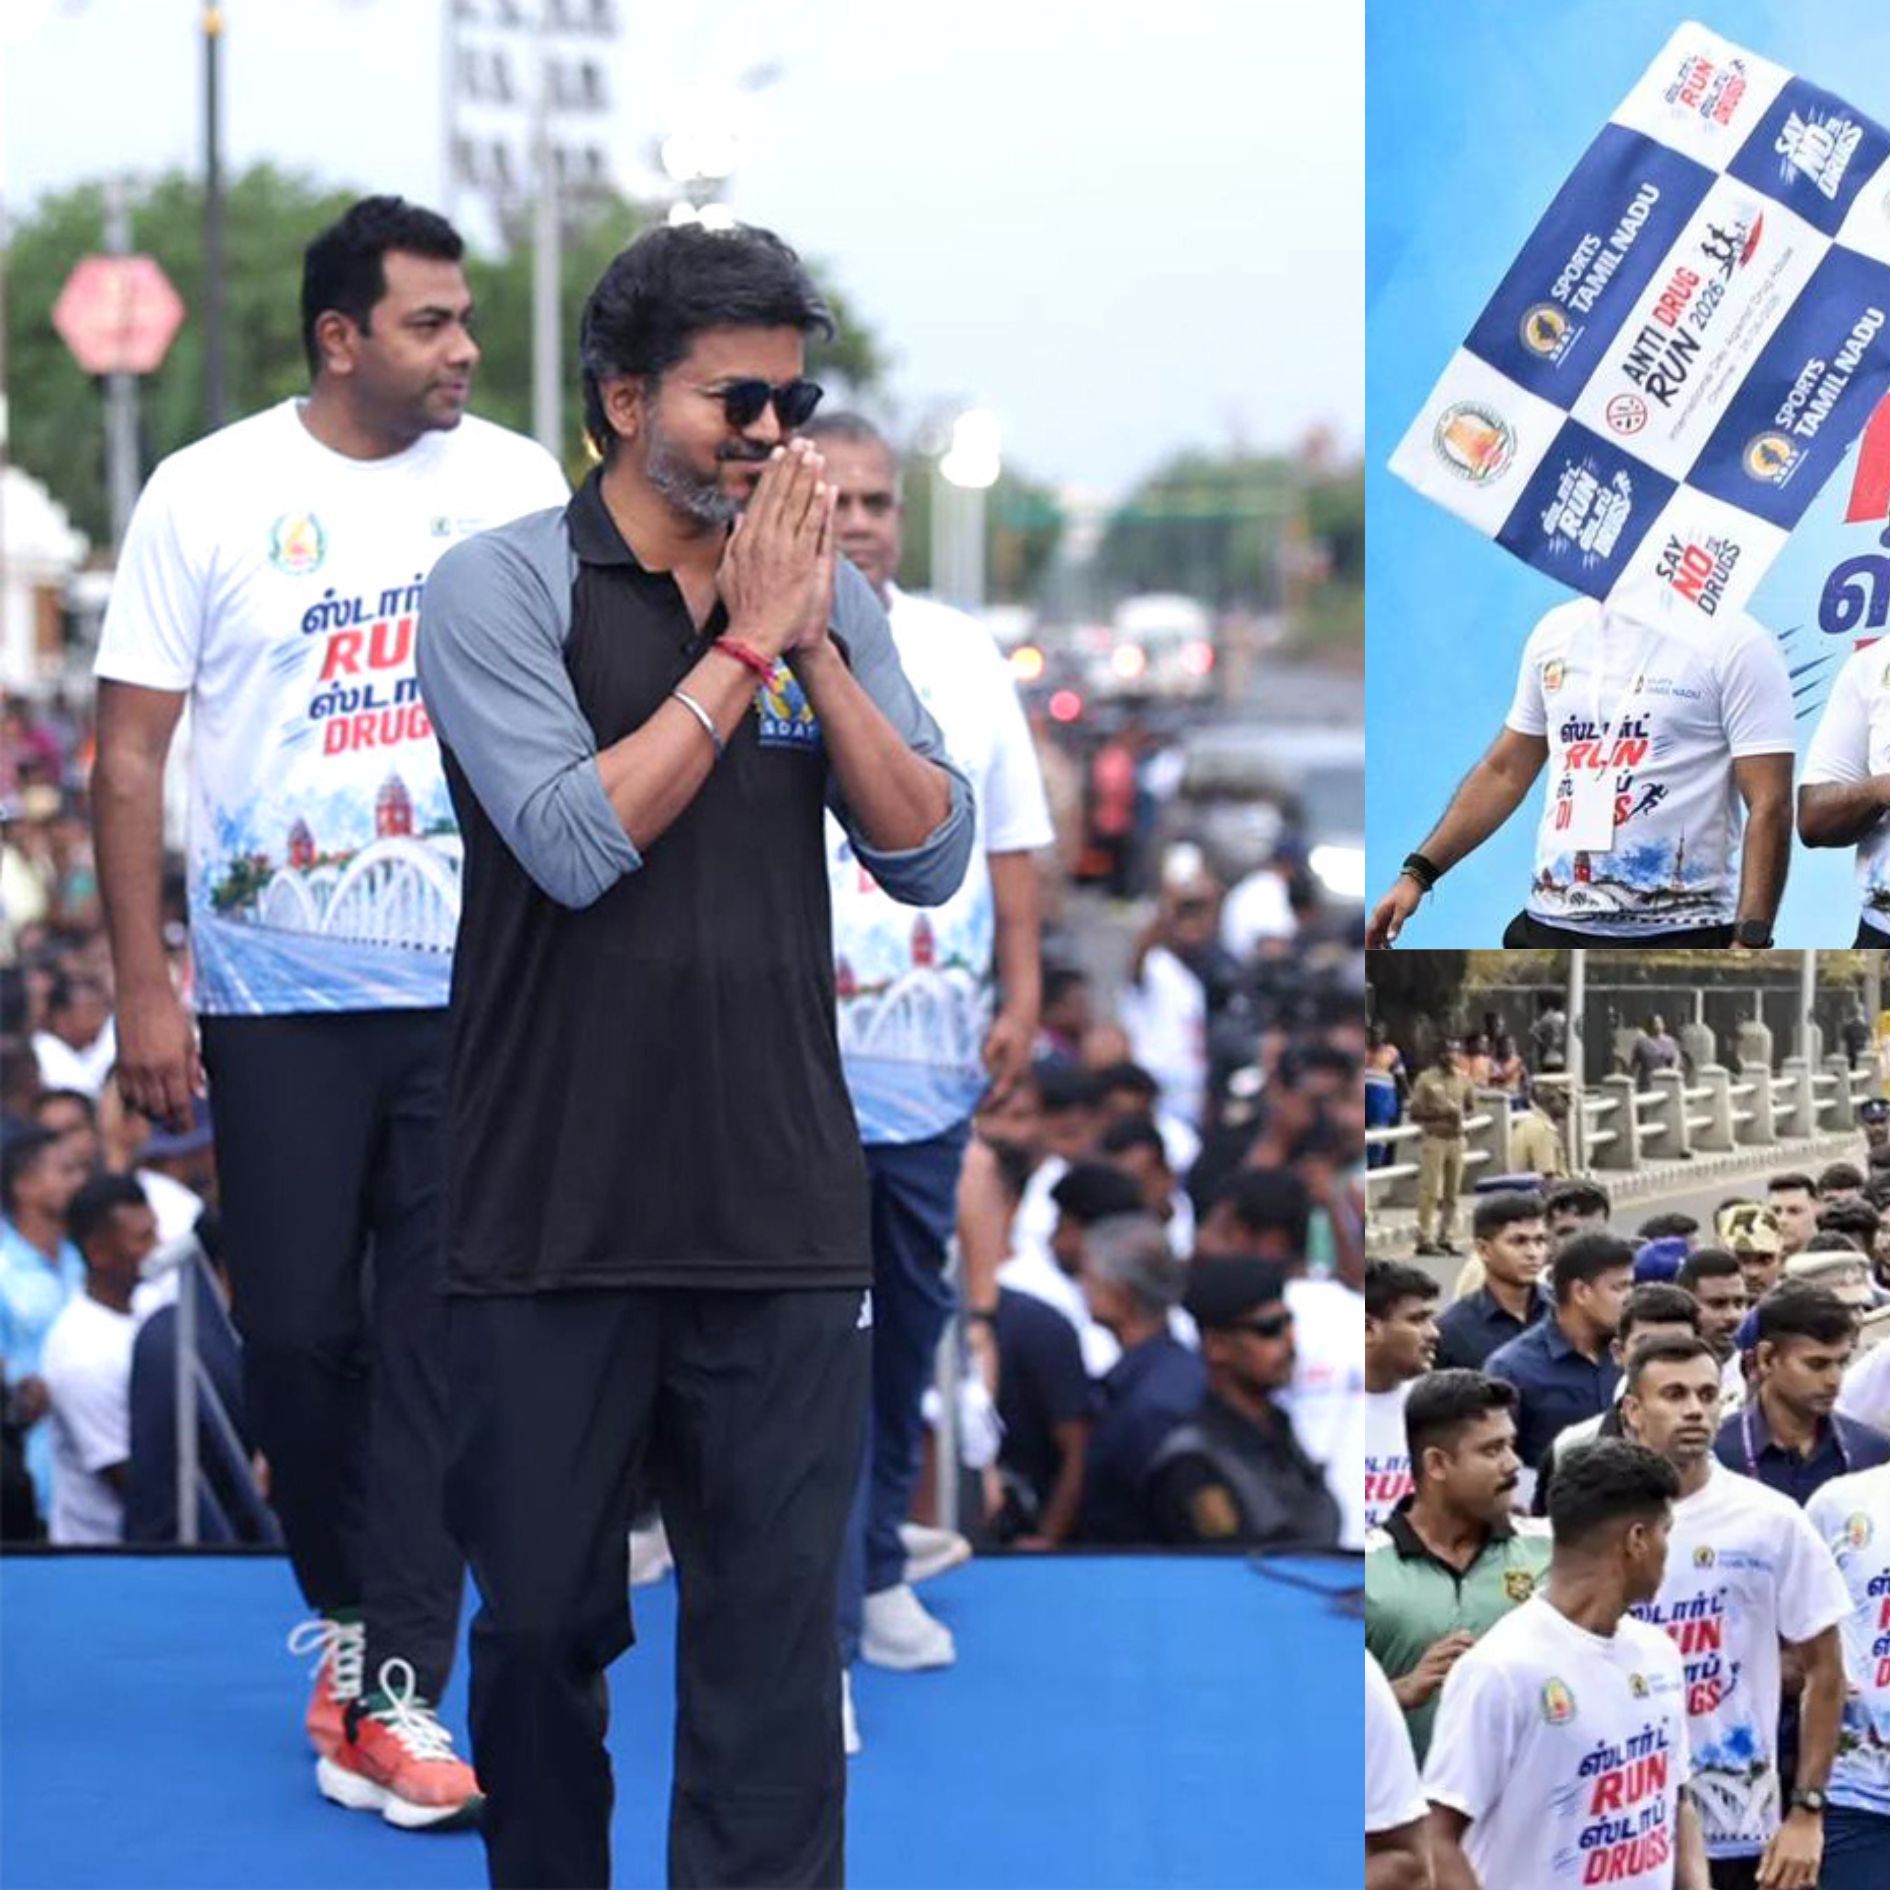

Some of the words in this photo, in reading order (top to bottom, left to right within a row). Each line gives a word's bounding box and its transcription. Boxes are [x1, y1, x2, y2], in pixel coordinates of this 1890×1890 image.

[1680, 57, 1714, 107] RUN
[1774, 111, 1806, 157] SAY
[1551, 233, 1602, 302] SPORTS
[1568, 248, 1624, 313] TAMIL
[1609, 182, 1661, 252] NADU
[1622, 325, 1667, 387] ANTI
[1651, 265, 1700, 329] DRUG
[1645, 326, 1701, 408] RUN
[1689, 278, 1726, 331] 2026
[1775, 356, 1825, 429] SPORTS
[1793, 372, 1849, 438] TAMIL
[1834, 306, 1885, 374] NADU
[1557, 469, 1599, 539] RUN
[1656, 534, 1685, 582] SAY
[1672, 543, 1713, 603] NO
[1698, 538, 1741, 616] DRUGS
[302, 573, 424, 635] ஸ்டார்
[319, 618, 413, 681] RU
[322, 702, 433, 757] DRUG
[1578, 1717, 1669, 1777] ஸ்டார்ட்
[1590, 1751, 1667, 1816] RUN
[1579, 1794, 1665, 1850] ஸ்டாப்
[1583, 1826, 1669, 1885] DRUGS
